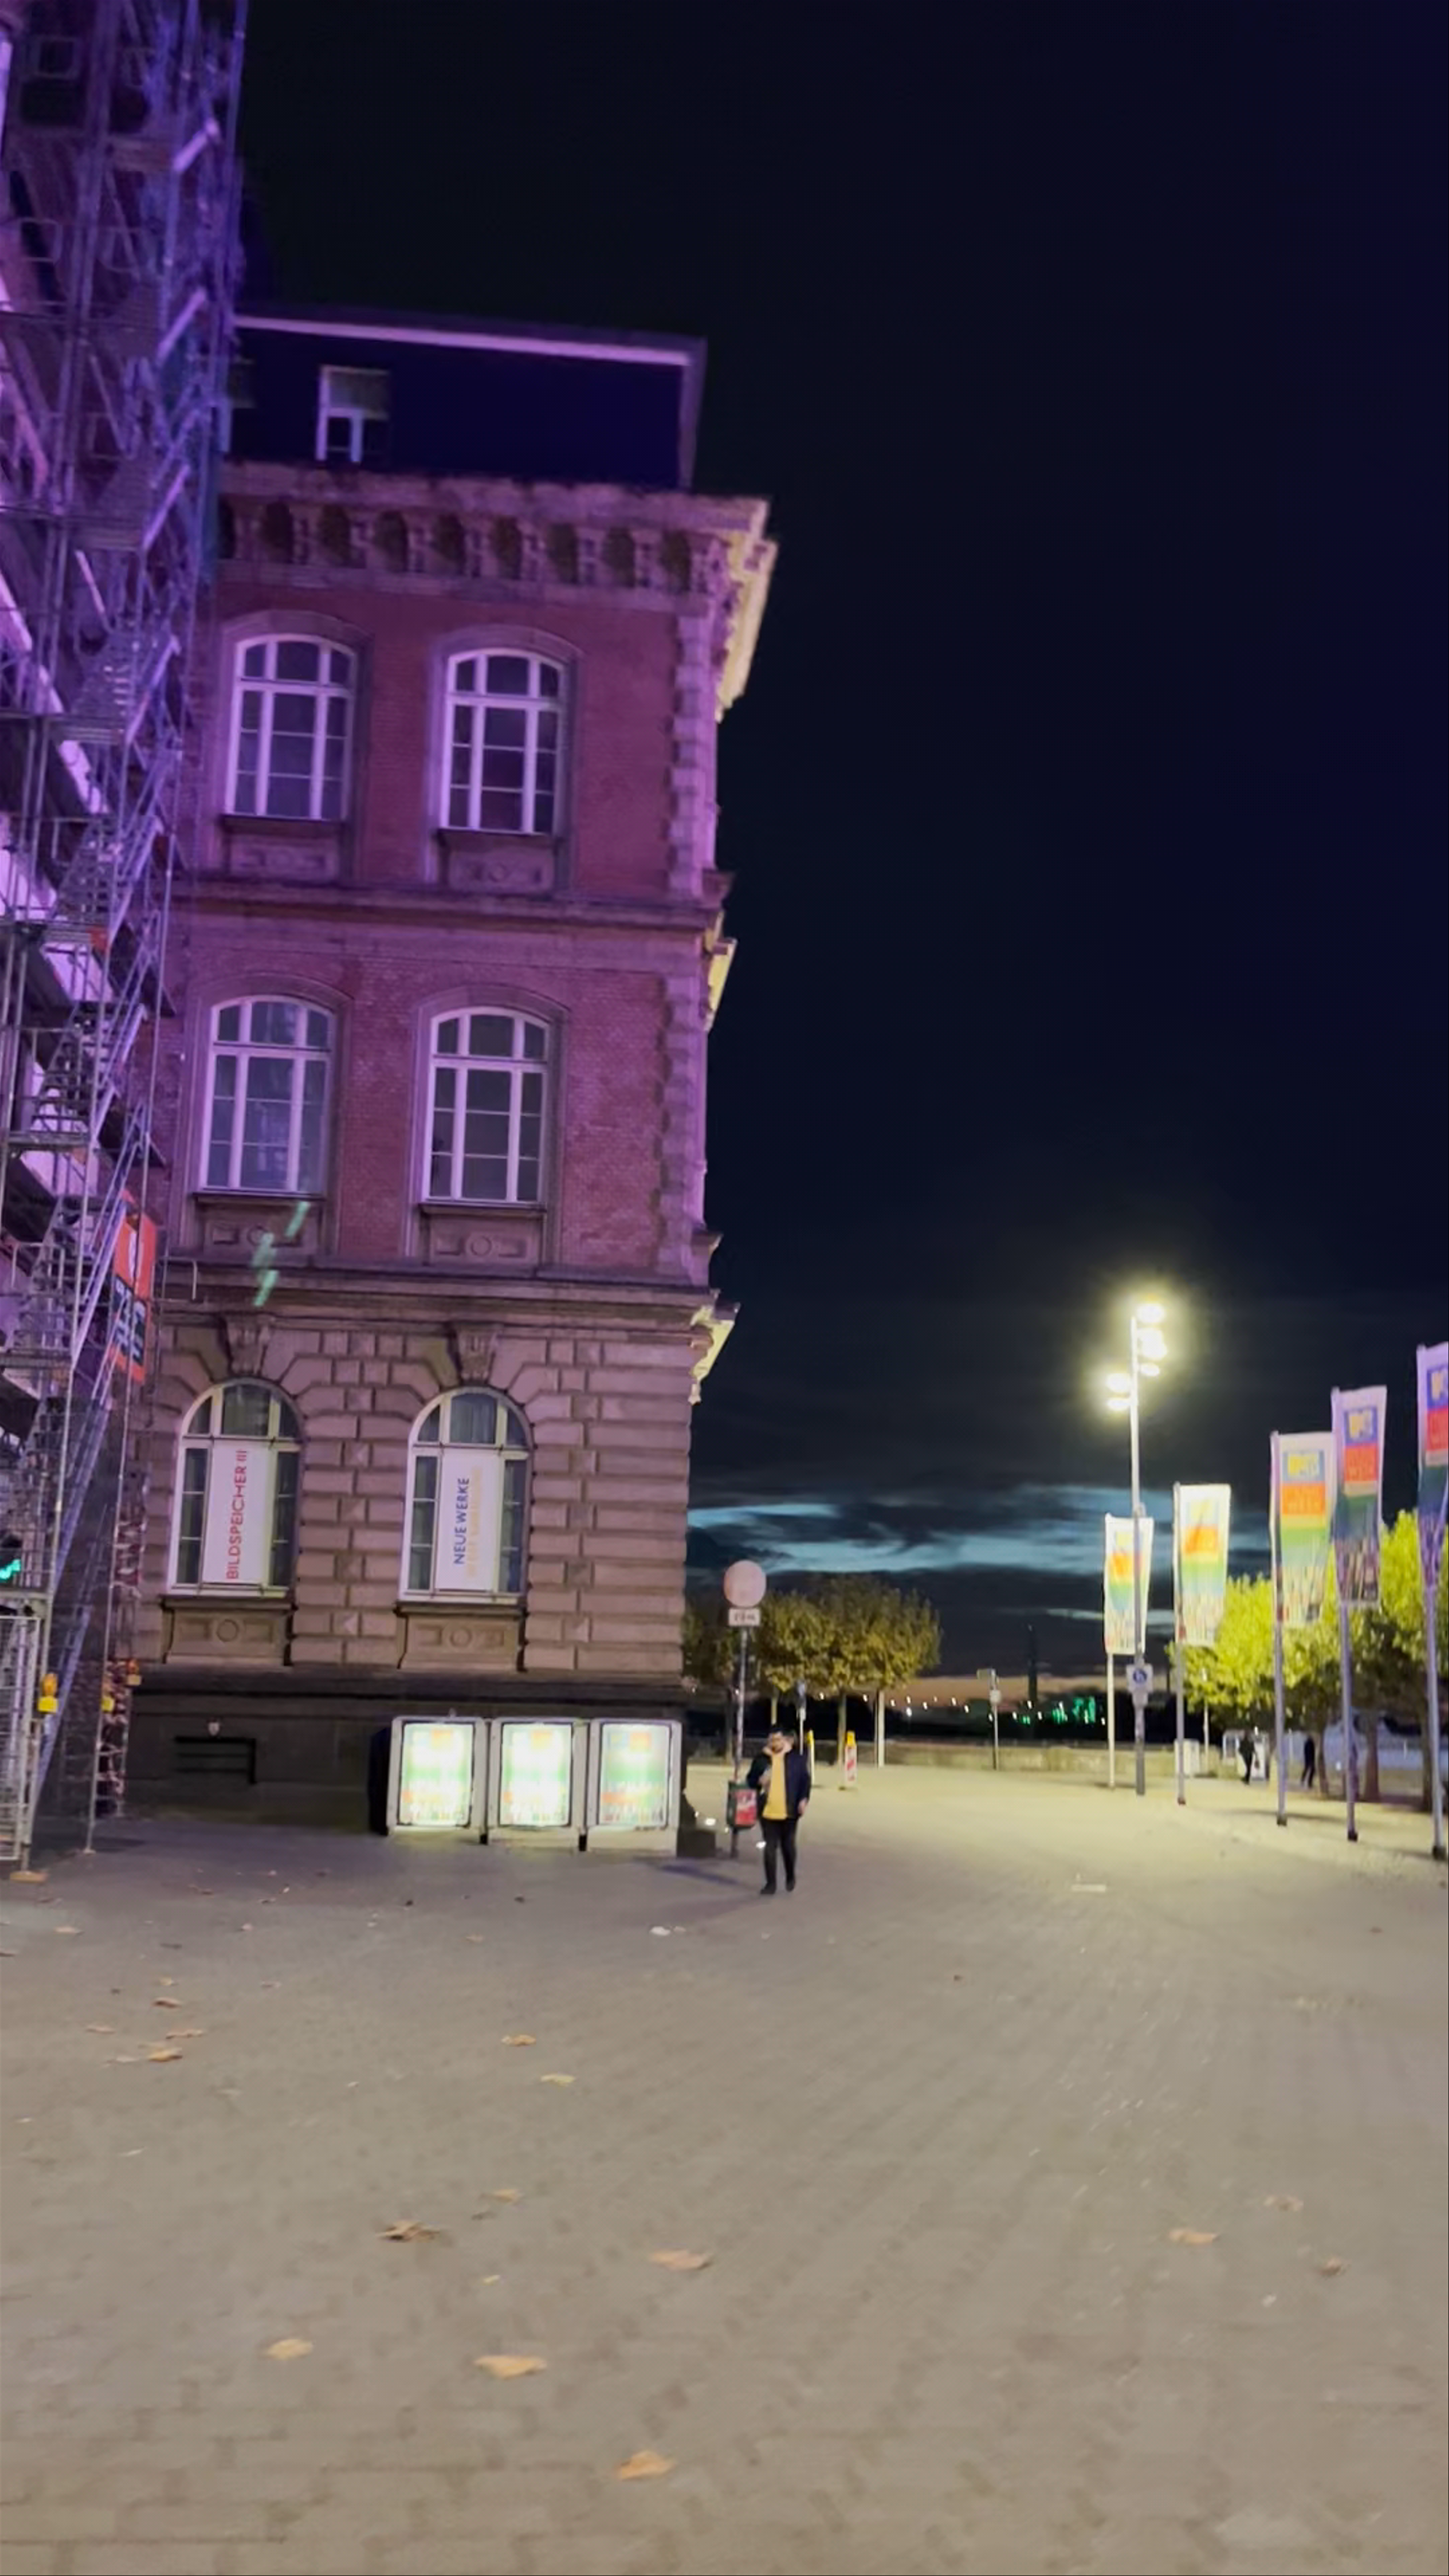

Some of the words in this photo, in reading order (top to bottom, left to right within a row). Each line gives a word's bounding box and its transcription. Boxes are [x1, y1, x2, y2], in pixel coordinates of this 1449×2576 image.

[236, 1450, 247, 1461] III
[455, 1478, 469, 1524] WERKE
[226, 1466, 247, 1579] BILDSPEICHER
[453, 1527, 467, 1564] NEUE
